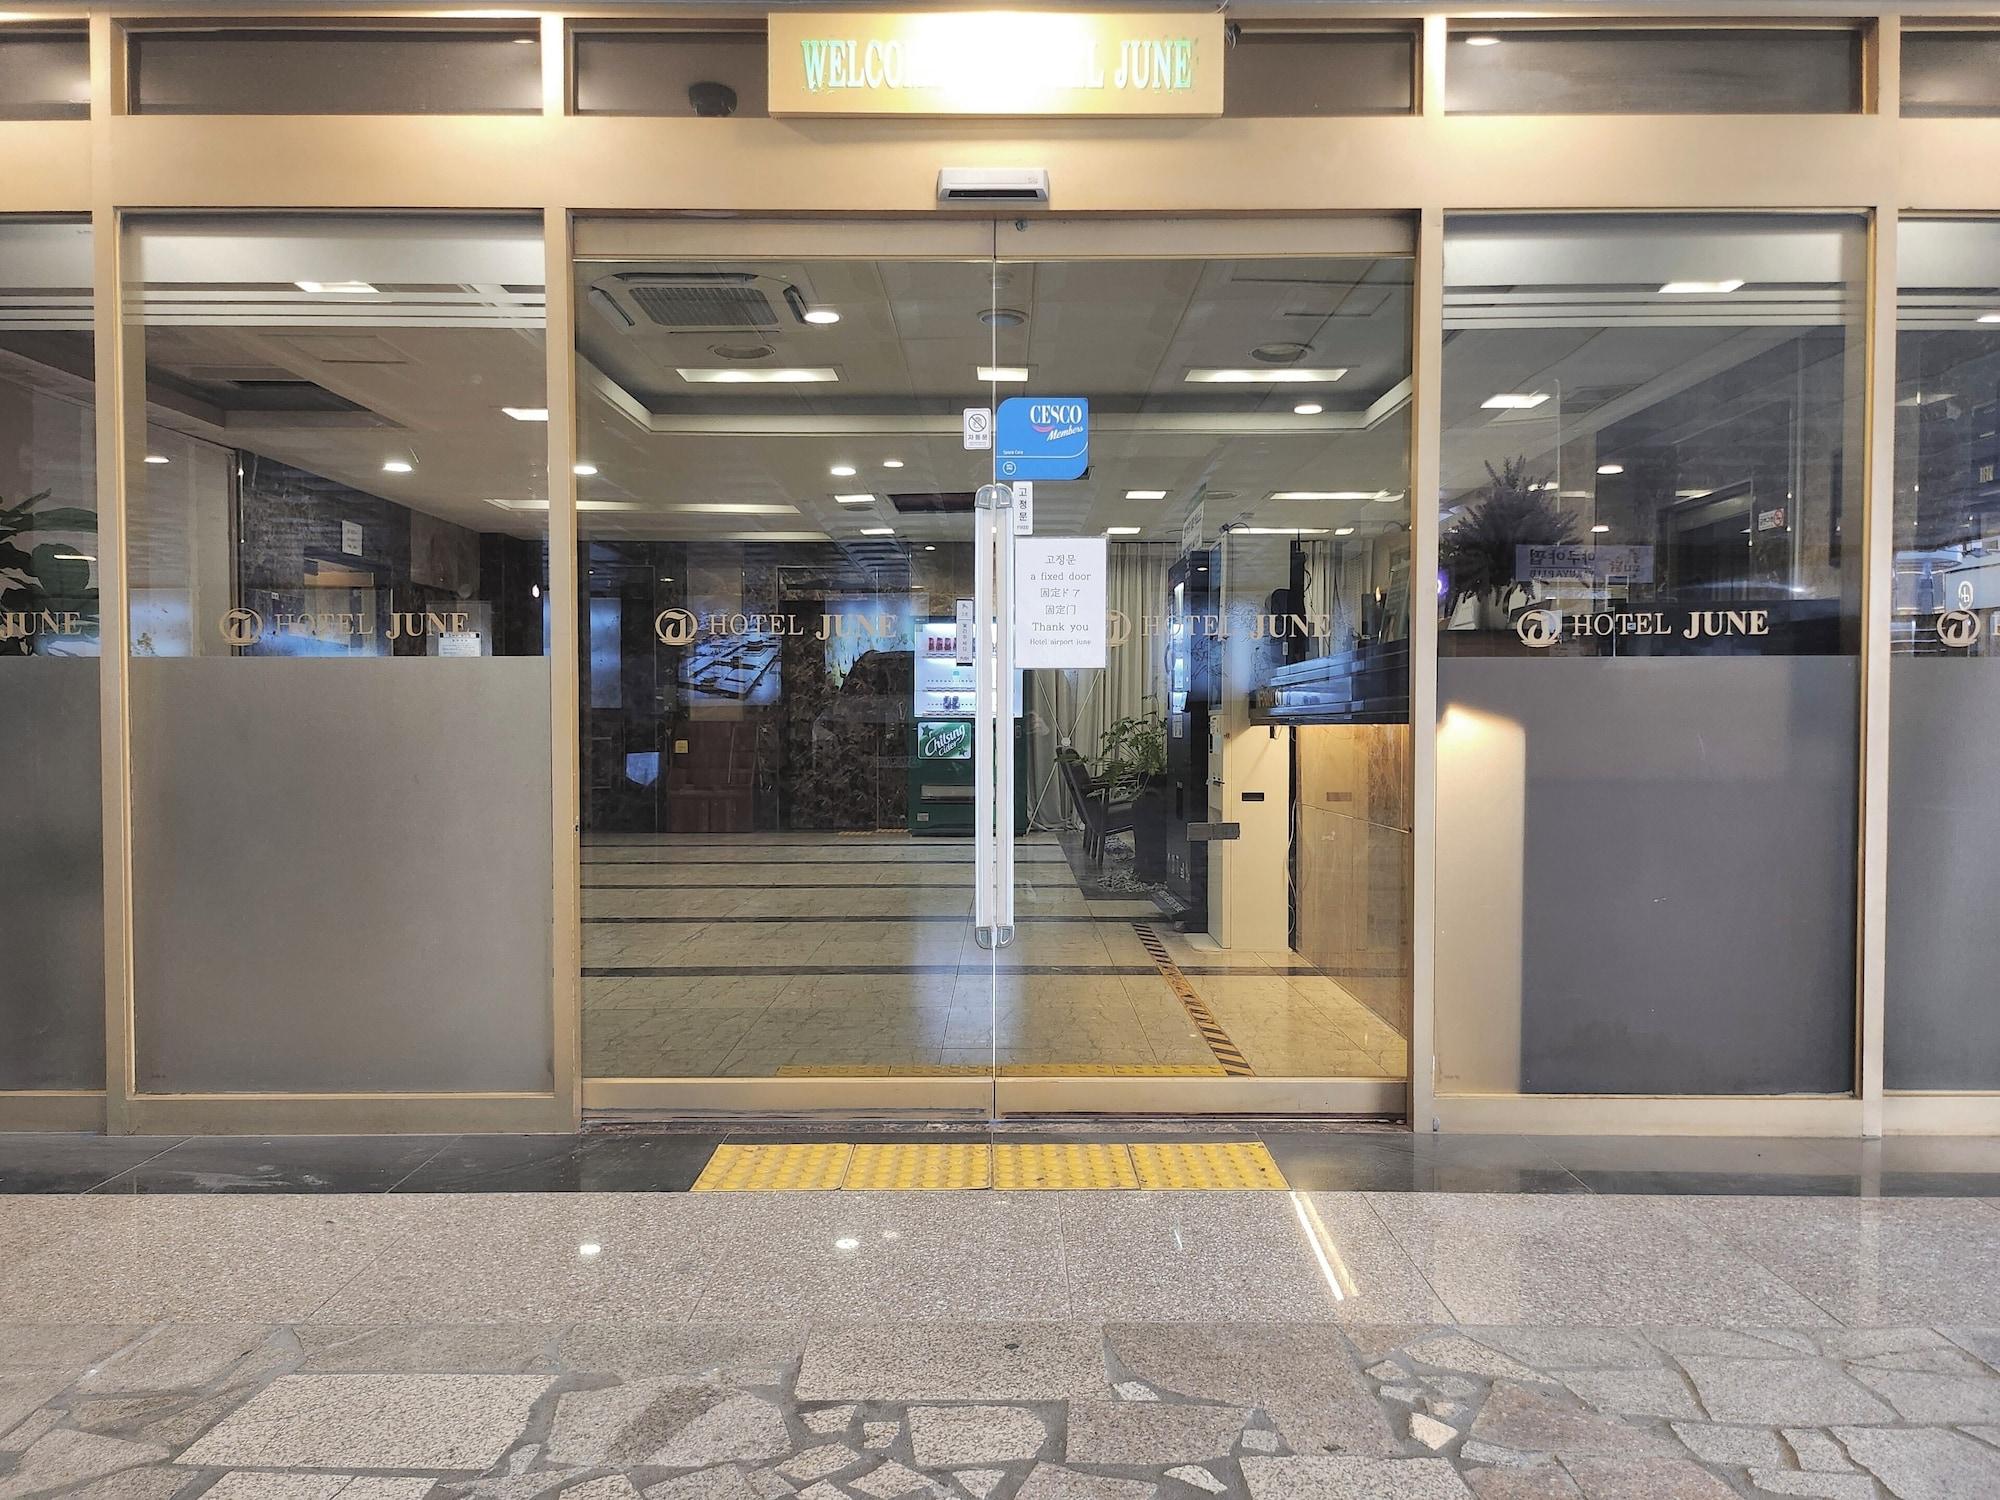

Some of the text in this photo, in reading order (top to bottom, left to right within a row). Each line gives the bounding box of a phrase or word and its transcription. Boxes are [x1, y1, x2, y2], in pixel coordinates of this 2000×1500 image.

[1114, 39, 1191, 89] JUNE
[1029, 404, 1082, 425] CESCO
[1046, 424, 1084, 442] Members
[1018, 487, 1028, 522] 고정문
[1045, 554, 1077, 565] 고정문
[1030, 572, 1091, 581] a fixed door
[0, 612, 82, 641] JUNE
[274, 612, 470, 640] HOTEL JUNE
[709, 614, 897, 641] HOTEL JUNE
[1032, 622, 1089, 632] Thank you
[1142, 613, 1332, 640] HOTEL JUNE
[1572, 610, 1769, 640] HOTEL JUNE
[1030, 638, 1047, 646] Hotel
[1050, 638, 1074, 647] airport
[925, 724, 965, 756] Chilsung
[939, 738, 958, 756] Cider
